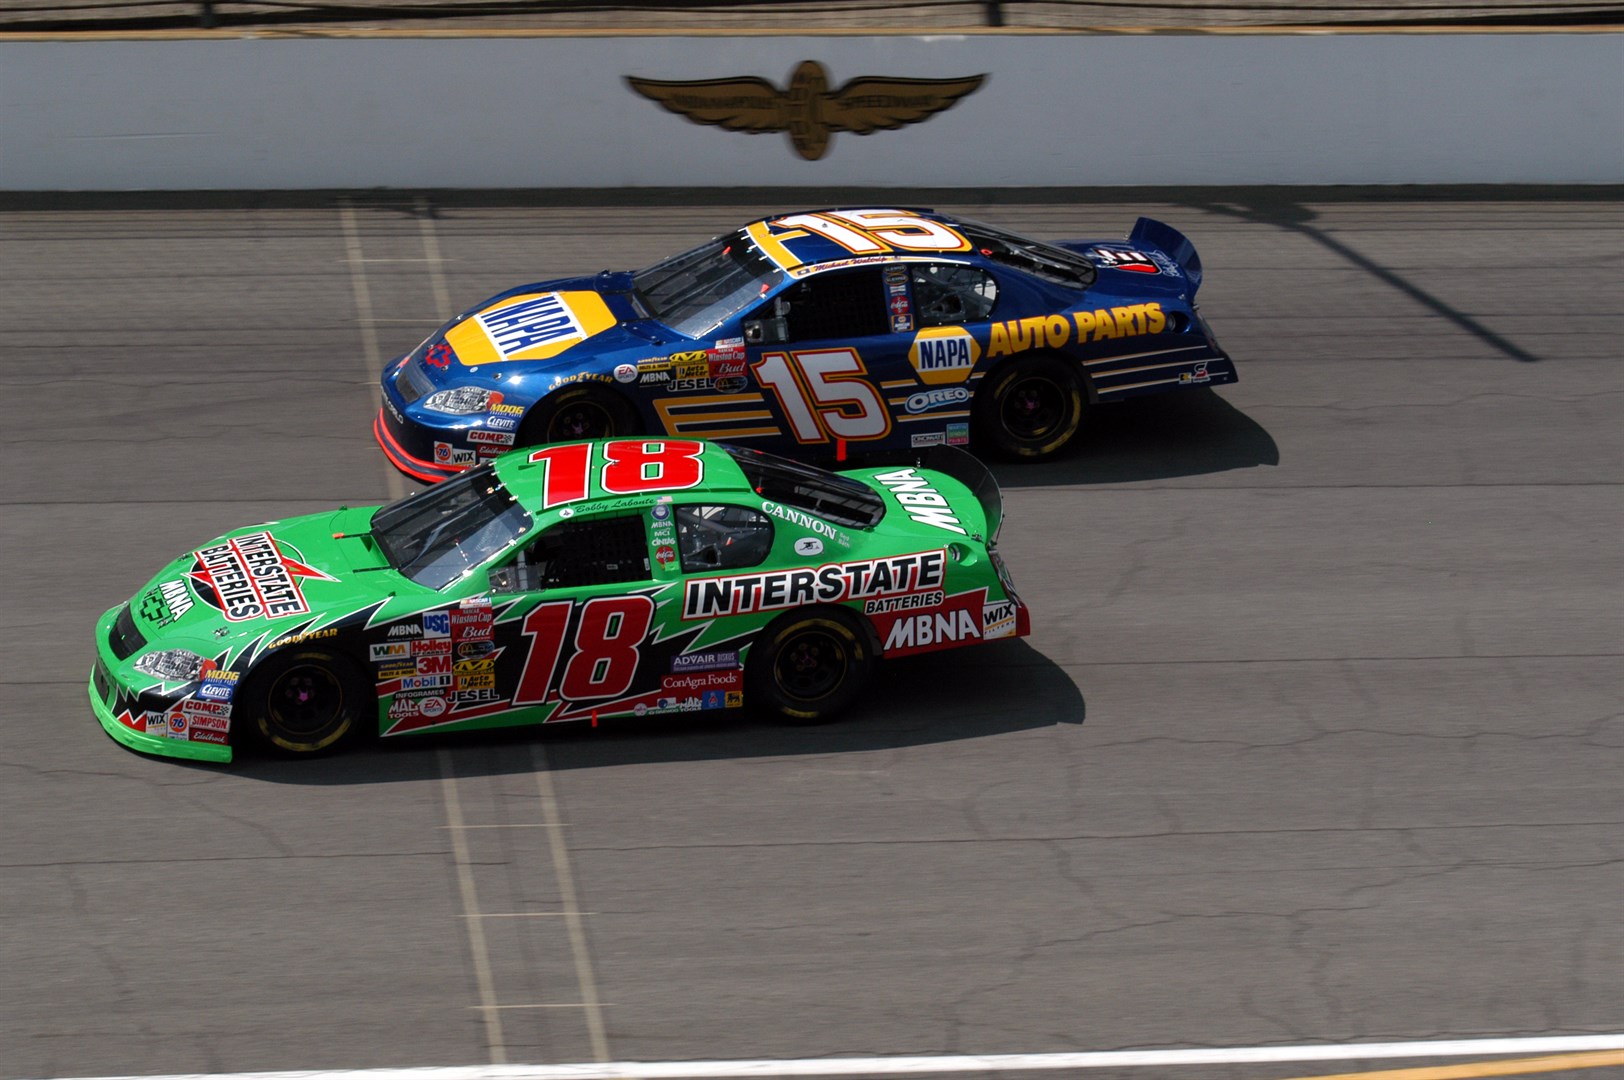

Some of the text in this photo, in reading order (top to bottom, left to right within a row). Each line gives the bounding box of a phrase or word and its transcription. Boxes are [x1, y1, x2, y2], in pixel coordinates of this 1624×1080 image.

[768, 209, 973, 255] 15
[480, 296, 578, 354] NAPA
[987, 302, 1167, 358] AUTO PARTS
[709, 351, 745, 361] Winston Cup
[919, 337, 971, 370] NAPA
[618, 366, 634, 374] EA
[719, 362, 746, 373] Bud
[548, 371, 613, 390] GOODYEAR
[639, 371, 671, 384] MBNA
[667, 379, 715, 391] JESEL
[750, 347, 892, 444] 15
[907, 388, 968, 411] OREO
[490, 403, 525, 414] MOOG
[487, 416, 514, 428] CLEVITE
[469, 432, 504, 442] COMP
[437, 449, 448, 457] 76
[454, 452, 474, 462] WIX
[529, 440, 704, 510] 18
[575, 499, 655, 513] Bobby Labonte
[873, 468, 969, 536] MBNA
[651, 521, 673, 529] MBNA
[762, 501, 837, 540] CANNON
[235, 533, 300, 615] INTERSTATE
[201, 545, 261, 618] BATTERIES
[685, 552, 944, 617] INTERSTATE
[159, 579, 195, 622] MBNA
[865, 591, 943, 614] BATTERIES
[451, 612, 492, 624] Winston Cup
[984, 602, 1014, 625] WIX
[387, 624, 422, 637] MBNA
[424, 614, 449, 634] USG
[883, 609, 981, 650] MBNA
[462, 625, 492, 638] Bud
[268, 628, 338, 649] GOODYEAR
[372, 645, 406, 656] WM
[412, 640, 451, 653] Holley
[512, 595, 655, 706] 18
[418, 656, 451, 674] 3M
[673, 654, 715, 665] ADVAIR
[205, 670, 240, 680] MOOG
[663, 672, 737, 689] ConAgra Foods
[402, 676, 436, 688] Mobil
[201, 684, 231, 697] CLEVITE
[395, 689, 444, 698] INFOGRAMES
[446, 688, 500, 703] JESEL
[185, 701, 220, 712] COMP
[388, 699, 419, 713] MAC
[147, 714, 165, 725] WIX
[388, 711, 419, 719] TOOLS
[172, 718, 184, 728] 76
[192, 715, 227, 729] SIMPSON
[193, 731, 225, 743] Edelbrock
